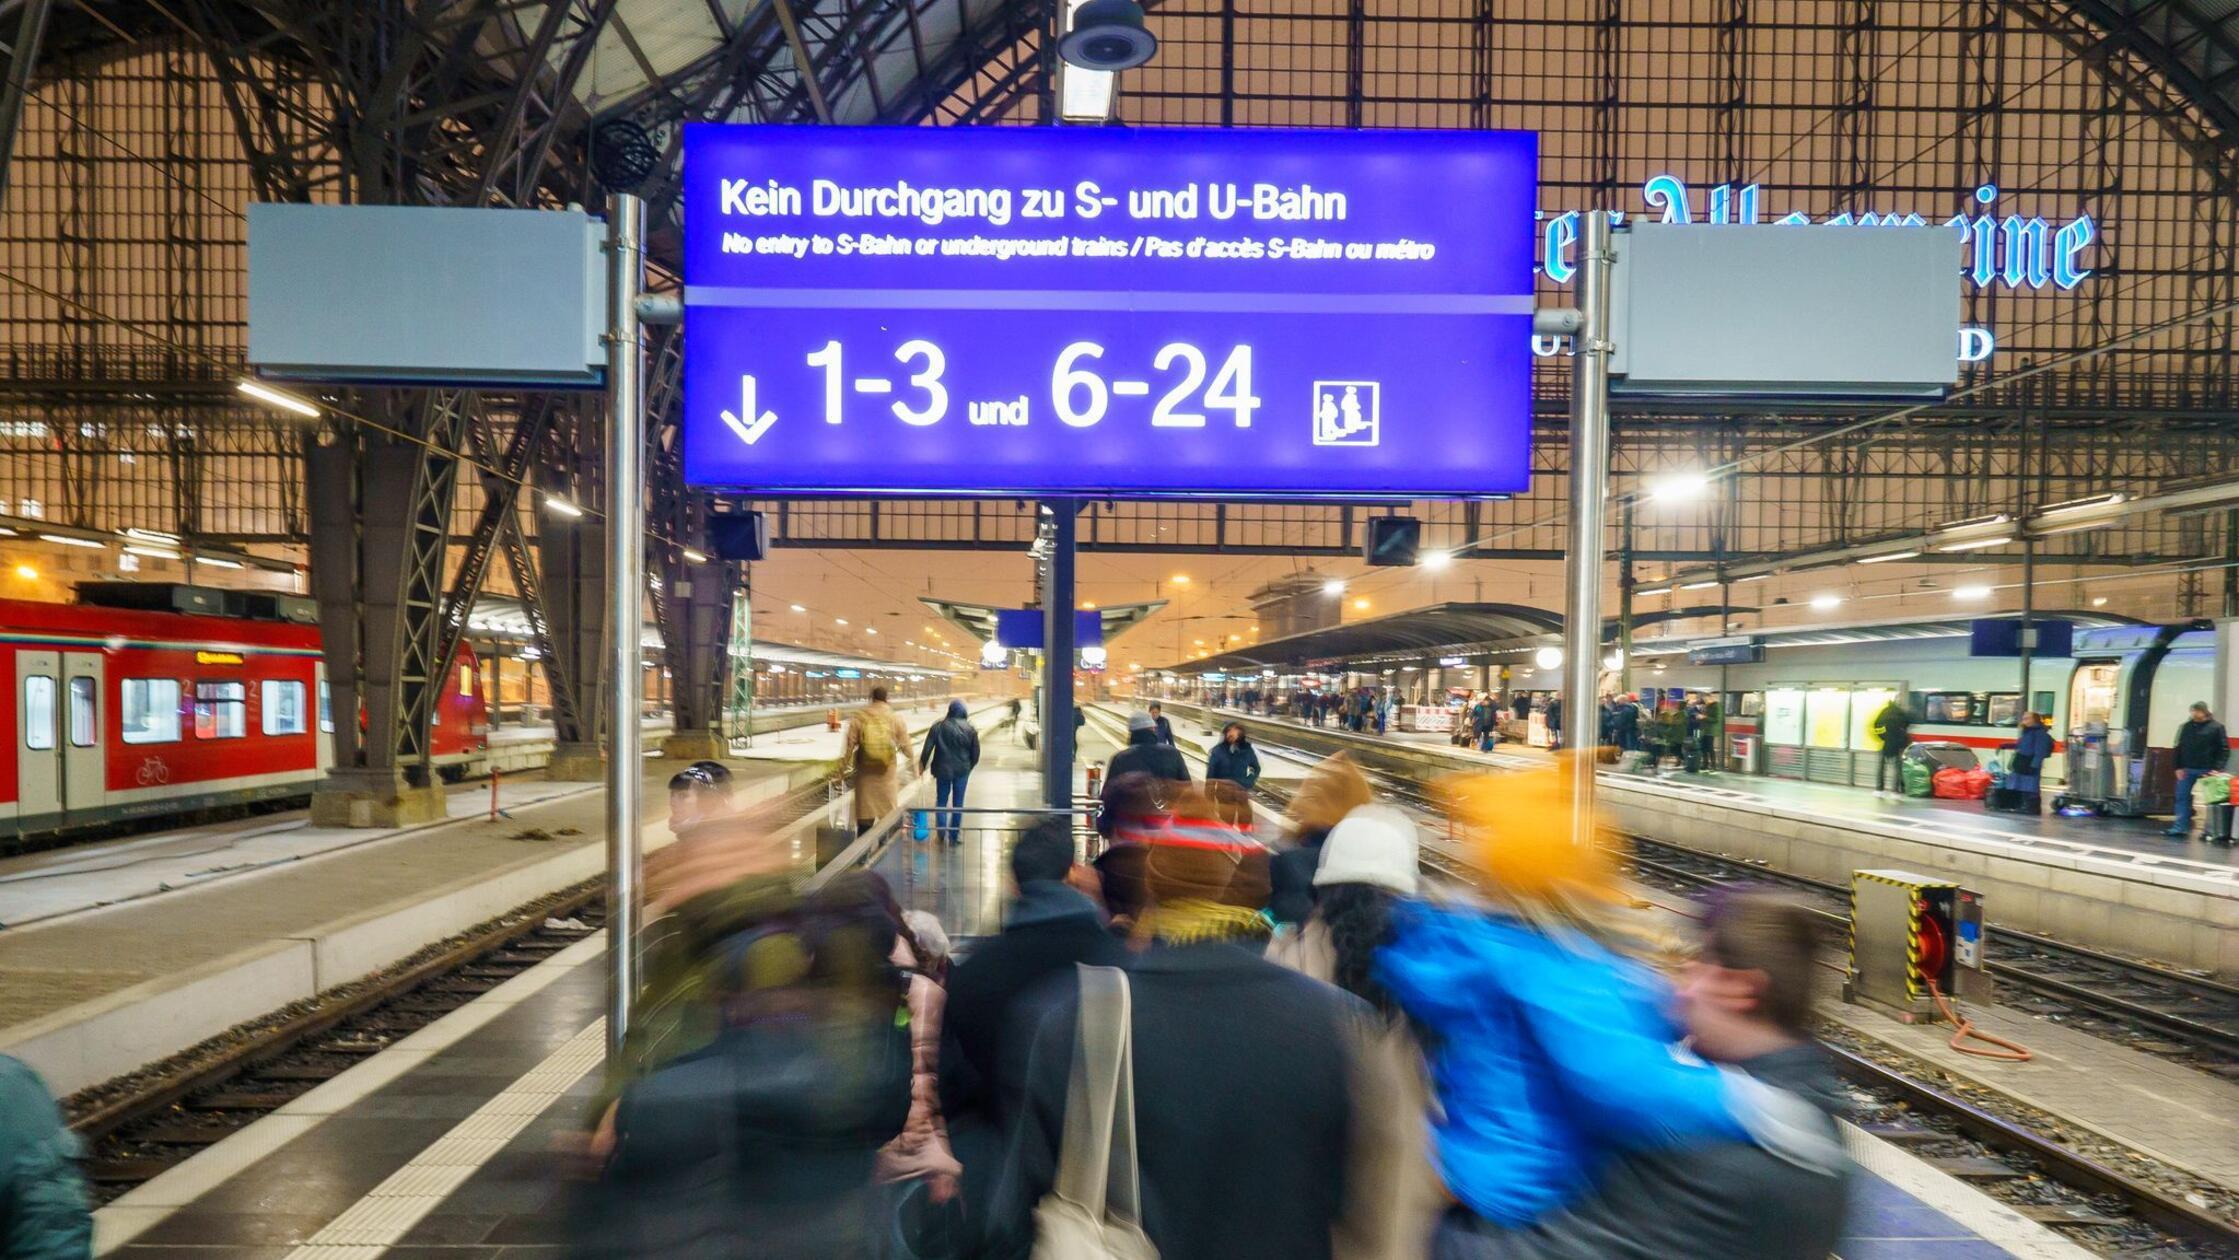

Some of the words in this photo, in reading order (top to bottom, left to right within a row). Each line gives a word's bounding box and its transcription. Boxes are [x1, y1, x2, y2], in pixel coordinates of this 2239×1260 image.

[722, 179, 802, 217] Kein
[812, 179, 1012, 226] Durchgang
[1020, 189, 1065, 218] zu
[1074, 181, 1119, 219] S-
[1128, 183, 1199, 219] und
[1208, 183, 1347, 221] U-Bahn
[722, 232, 753, 254] No
[755, 233, 811, 259] entry
[811, 234, 835, 254] to
[836, 233, 913, 256] S-Bahn
[914, 237, 940, 255] or
[940, 235, 1069, 260] underground
[1070, 235, 1128, 257] trains
[1129, 236, 1144, 257] /
[1145, 237, 1184, 257] Pas
[1185, 236, 1265, 259] d'accès
[1266, 238, 1344, 259] S-Bahn
[1345, 242, 1374, 260] ou
[1374, 238, 1436, 260] métro
[806, 340, 949, 428] 1-3
[968, 395, 1030, 427] und
[1051, 341, 1262, 429] 6-24
[248, 680, 257, 697] 2
